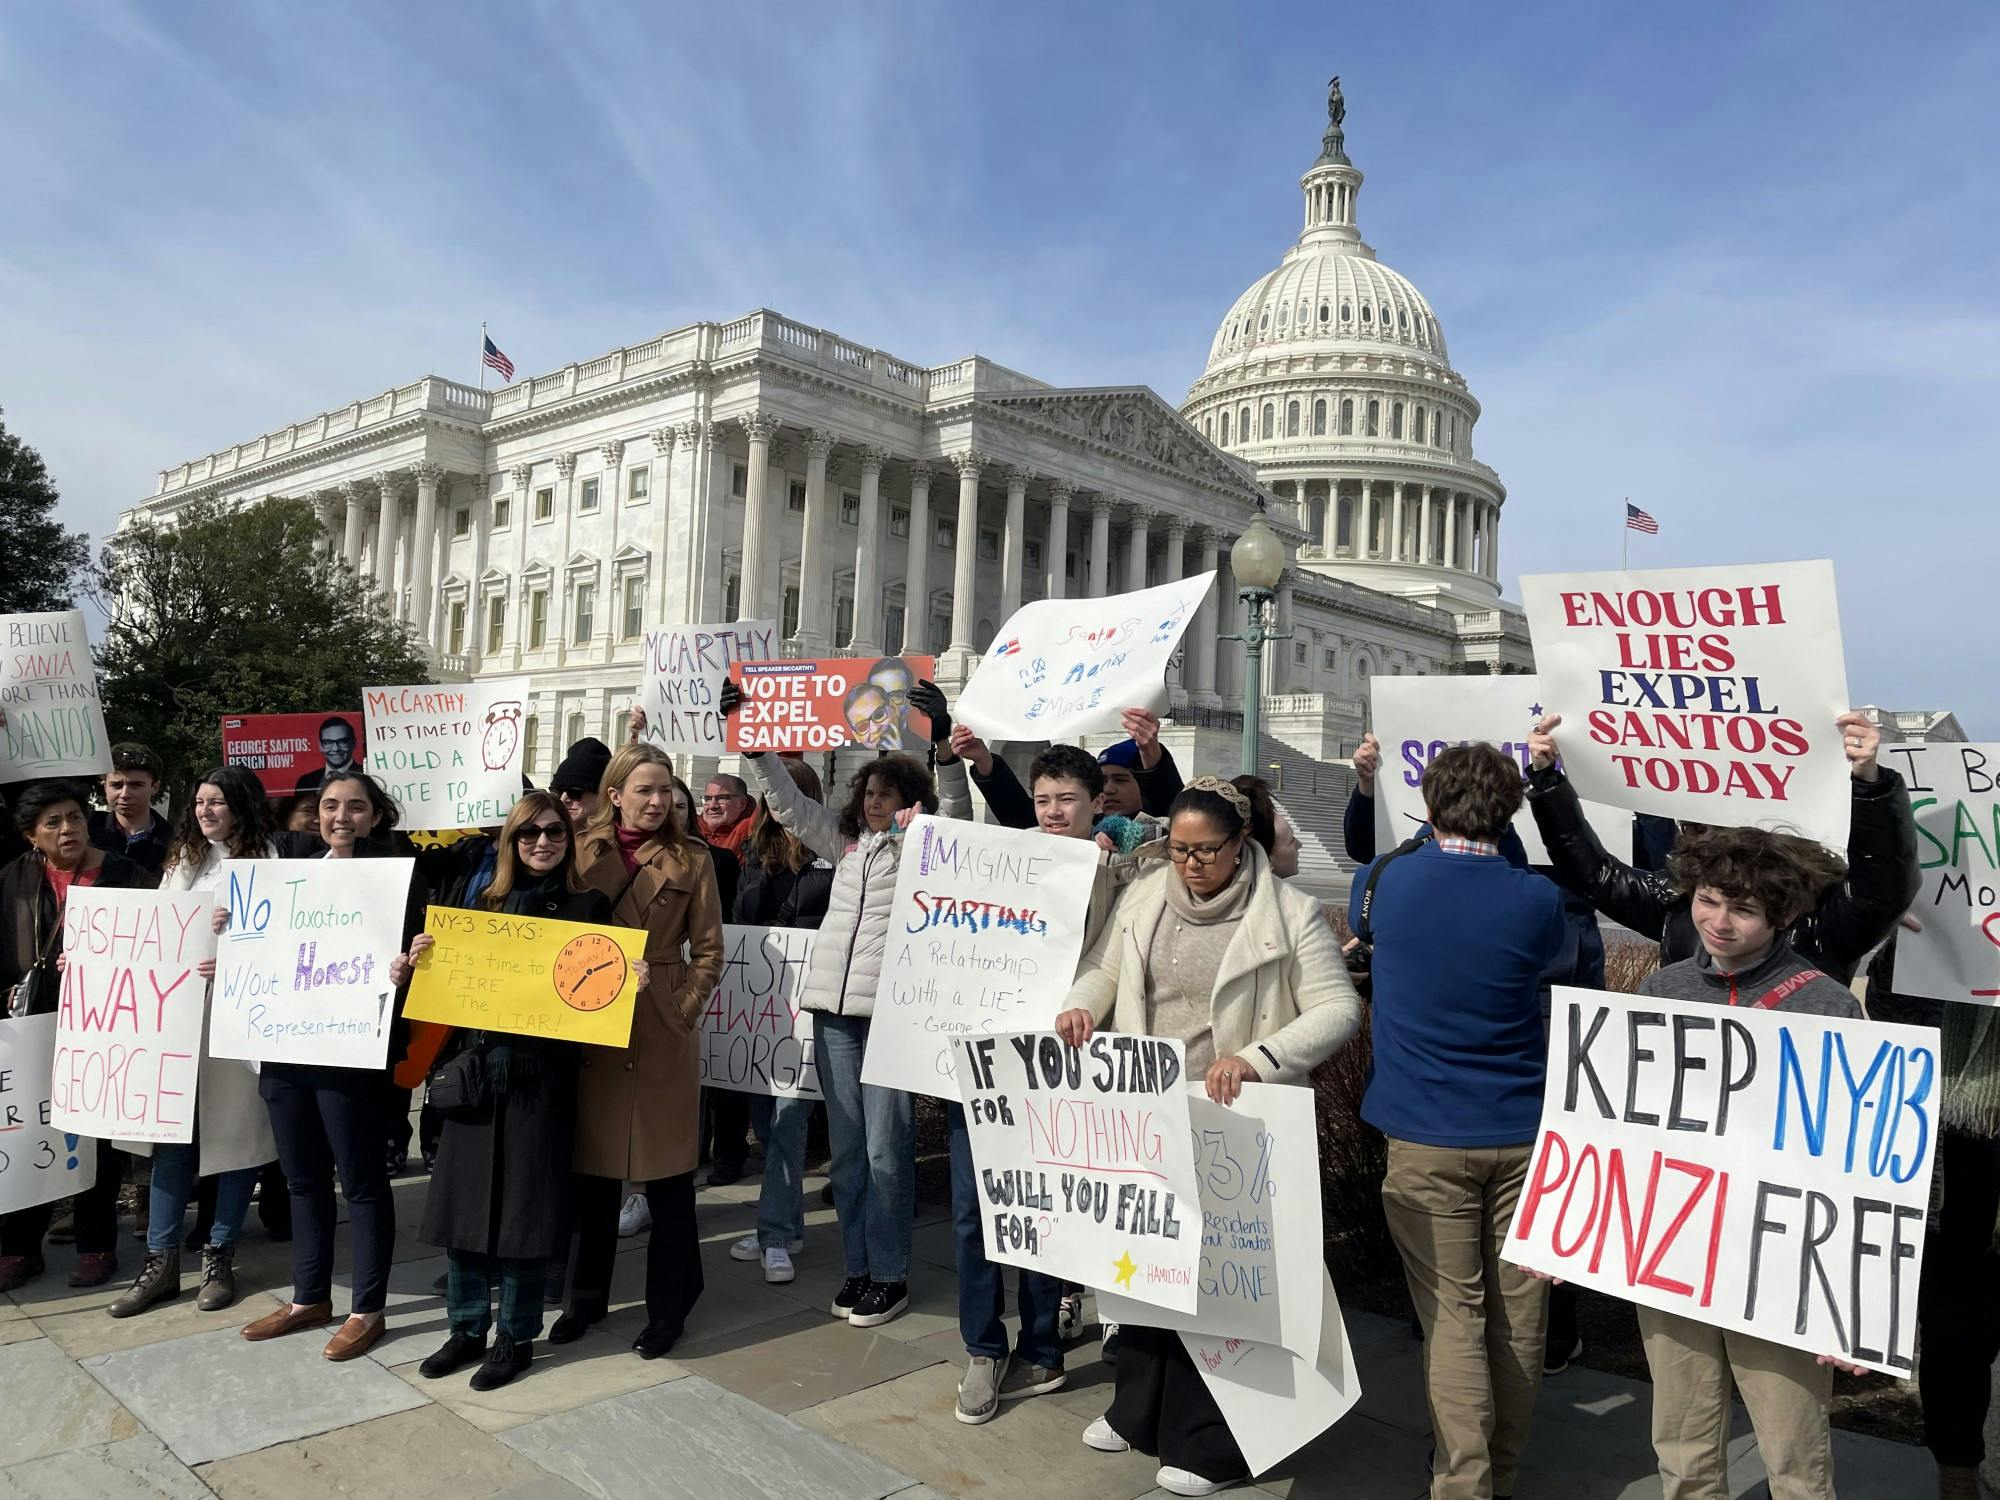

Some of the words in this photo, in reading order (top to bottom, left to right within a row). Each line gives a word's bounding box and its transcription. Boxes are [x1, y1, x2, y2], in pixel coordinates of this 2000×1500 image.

[1560, 584, 1786, 628] ENOUGH
[10, 622, 72, 648] BELIEVE
[644, 628, 771, 675] MCCARTHY
[1616, 632, 1736, 672] LIES
[11, 651, 75, 679] SANTA
[1, 686, 37, 704] ORE
[44, 681, 95, 699] THAN
[659, 678, 711, 705] NY-03
[740, 675, 806, 698] VOTE
[810, 674, 846, 697] TO
[1599, 670, 1779, 714] EXPEL
[739, 701, 818, 723] EXPEL
[3, 704, 96, 761] SANTOS
[228, 740, 268, 755] GEORGE
[270, 738, 312, 753] SANTOS:
[375, 724, 397, 741] IT'S
[407, 723, 447, 740] TIME
[451, 721, 472, 736] TO
[738, 725, 851, 748] SANTOS.
[1588, 710, 1810, 757] SANTOS
[228, 755, 265, 770] RESIGN
[267, 754, 294, 768] NOW!
[374, 749, 441, 770] HOLD
[452, 749, 464, 768] A
[1890, 747, 1934, 792] I
[393, 782, 431, 803] OTE
[447, 781, 468, 801] TO
[1612, 754, 1795, 800] TODAY
[228, 865, 271, 931] No
[285, 879, 363, 930] Taxation
[906, 890, 1047, 936] STARTING
[1362, 890, 1372, 919] SONY
[64, 903, 201, 963] SASHAY
[432, 912, 475, 933] NY-3
[487, 919, 543, 941] SAYS:
[592, 937, 601, 945] 12
[294, 941, 375, 991] Honest
[437, 947, 474, 965] It's
[486, 951, 520, 974] time
[528, 959, 545, 975] to
[718, 932, 808, 997] ASH
[898, 943, 912, 966] A
[928, 940, 1038, 983] Relationship
[60, 962, 190, 1033] AWAY
[448, 969, 505, 993] FIRE
[893, 978, 938, 1006] With
[953, 992, 965, 1005] a
[456, 994, 489, 1012] The
[702, 988, 801, 1040] AWAY
[496, 1013, 562, 1033] LIAR!
[1010, 1035, 1081, 1090] YOU
[1090, 1037, 1180, 1096] STAND
[52, 1043, 193, 1125] GEORGE
[1563, 1003, 1757, 1137] KEEP
[1773, 1027, 1935, 1184] NY-03
[970, 1095, 1015, 1126] FOR
[1025, 1098, 1162, 1168] NOTHING
[982, 1169, 1053, 1212] WILL
[1061, 1173, 1109, 1224] YOU
[1115, 1183, 1180, 1240] FALL
[1204, 1209, 1268, 1234] Residents
[1515, 1130, 1729, 1307] PONZI
[1743, 1180, 1924, 1370] FREE
[1147, 1266, 1190, 1286] HAMILTON
[1198, 1256, 1272, 1302] GONE
[1199, 1347, 1222, 1372] Your
